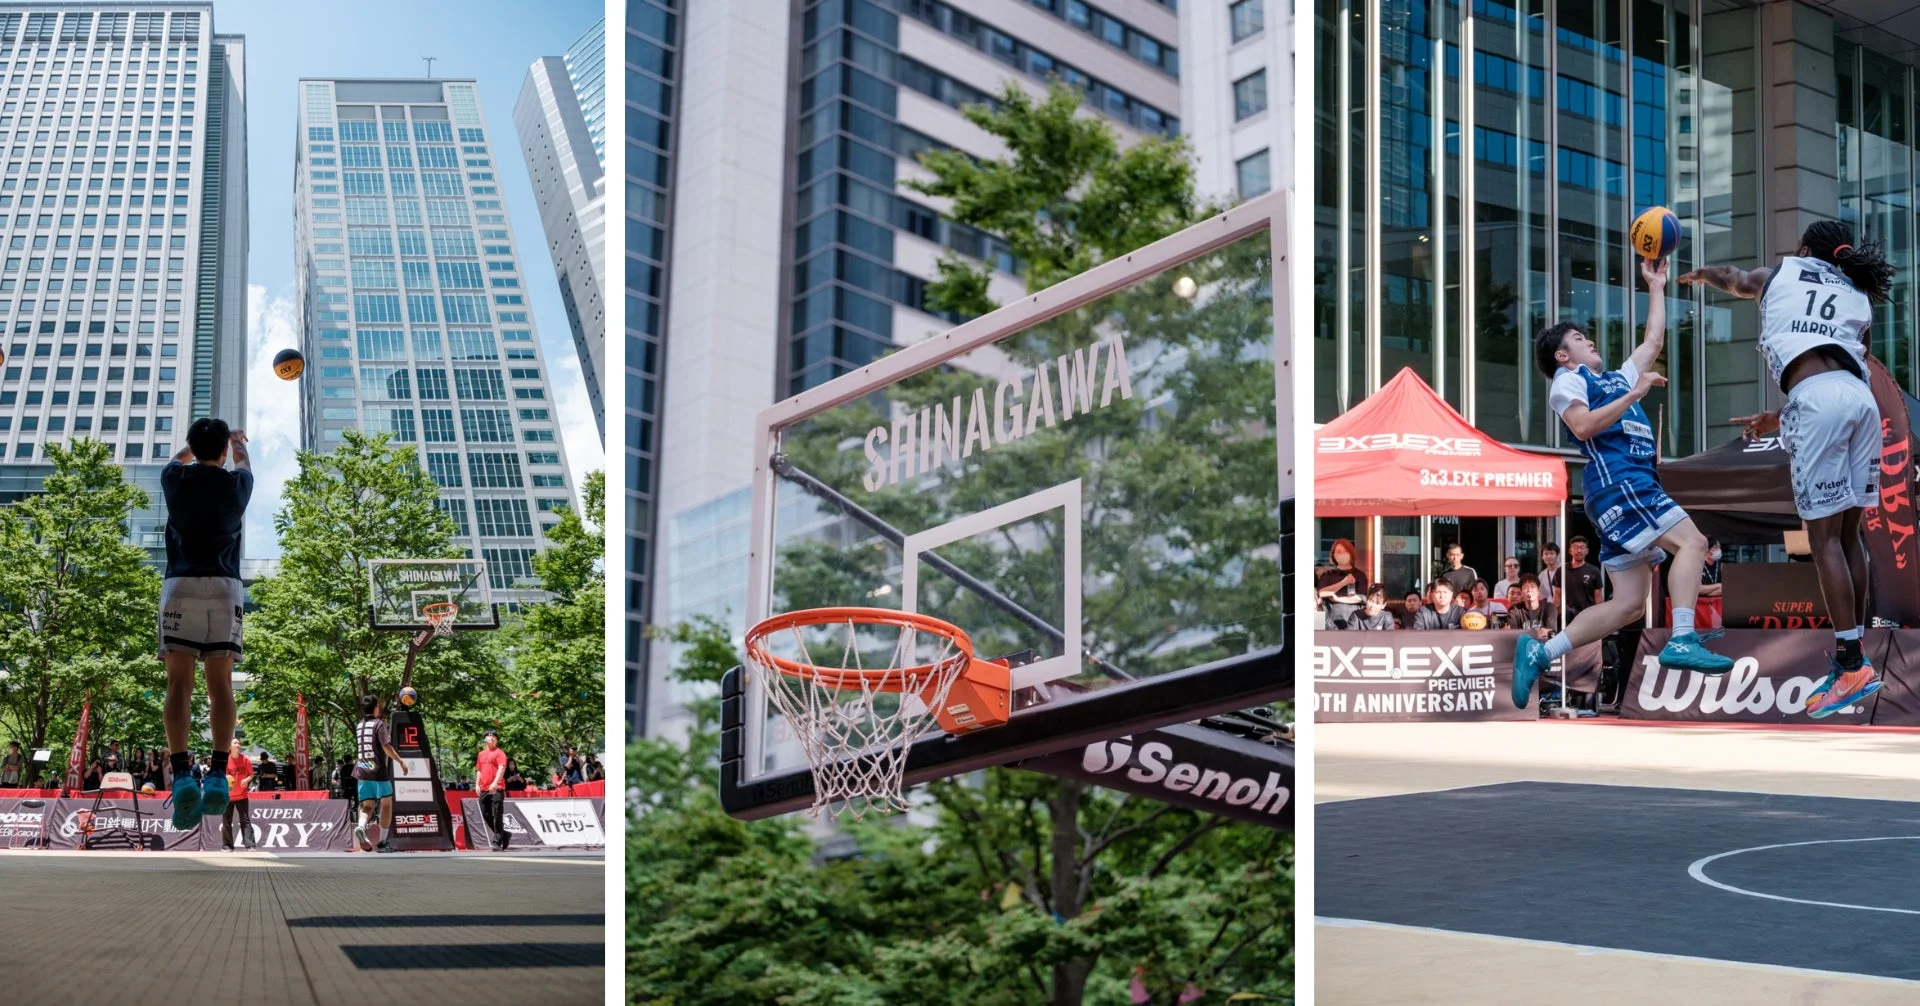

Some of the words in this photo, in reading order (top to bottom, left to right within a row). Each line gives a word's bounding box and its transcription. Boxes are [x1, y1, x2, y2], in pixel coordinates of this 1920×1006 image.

[1806, 290, 1838, 320] 16
[1791, 320, 1837, 338] HARRY
[862, 333, 1133, 493] SHINAGAWA
[1420, 469, 1480, 486] 3x3.EXE
[1484, 472, 1553, 487] PREMIER
[399, 569, 461, 582] SHINAGAWA
[1773, 602, 1813, 612] SUPER
[1429, 677, 1495, 691] PREMIER
[1638, 655, 1855, 715] Wilso
[1353, 690, 1495, 713] ANNIVERSARY
[404, 726, 419, 744] 12
[1127, 741, 1290, 815] Senoh
[251, 808, 303, 819] SUPER
[537, 813, 595, 833] inゼリー
